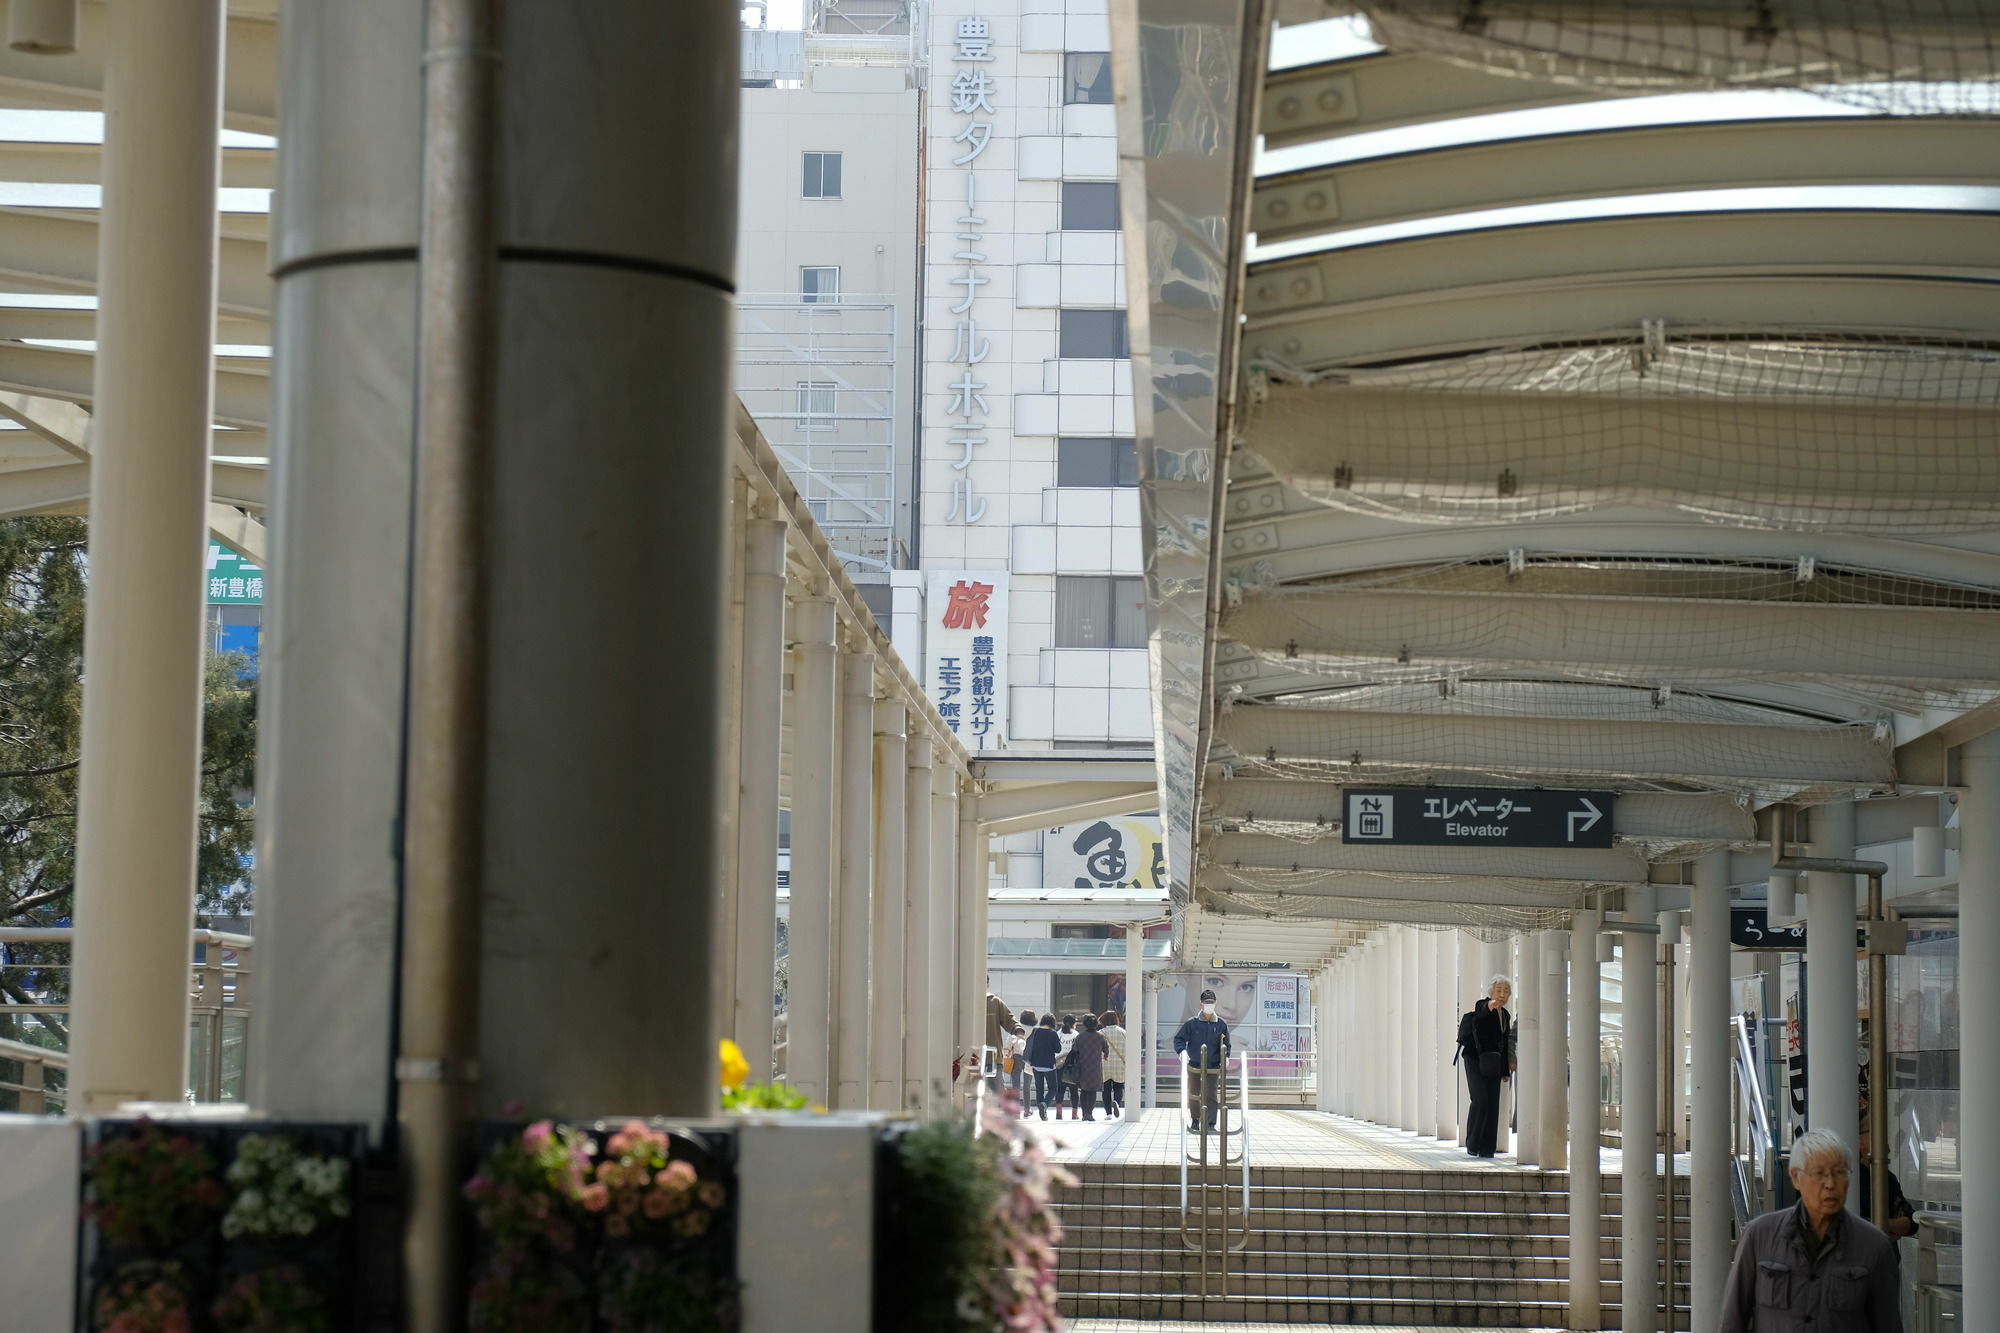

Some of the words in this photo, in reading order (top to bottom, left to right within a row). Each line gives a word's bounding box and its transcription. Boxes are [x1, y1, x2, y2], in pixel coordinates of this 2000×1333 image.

[946, 16, 996, 525] 豊鉄ターミナルホテル
[942, 580, 994, 630] 旅
[970, 635, 995, 750] 豊鉄観光サー
[1423, 797, 1532, 820] エレベーター
[1446, 823, 1509, 837] Elevator
